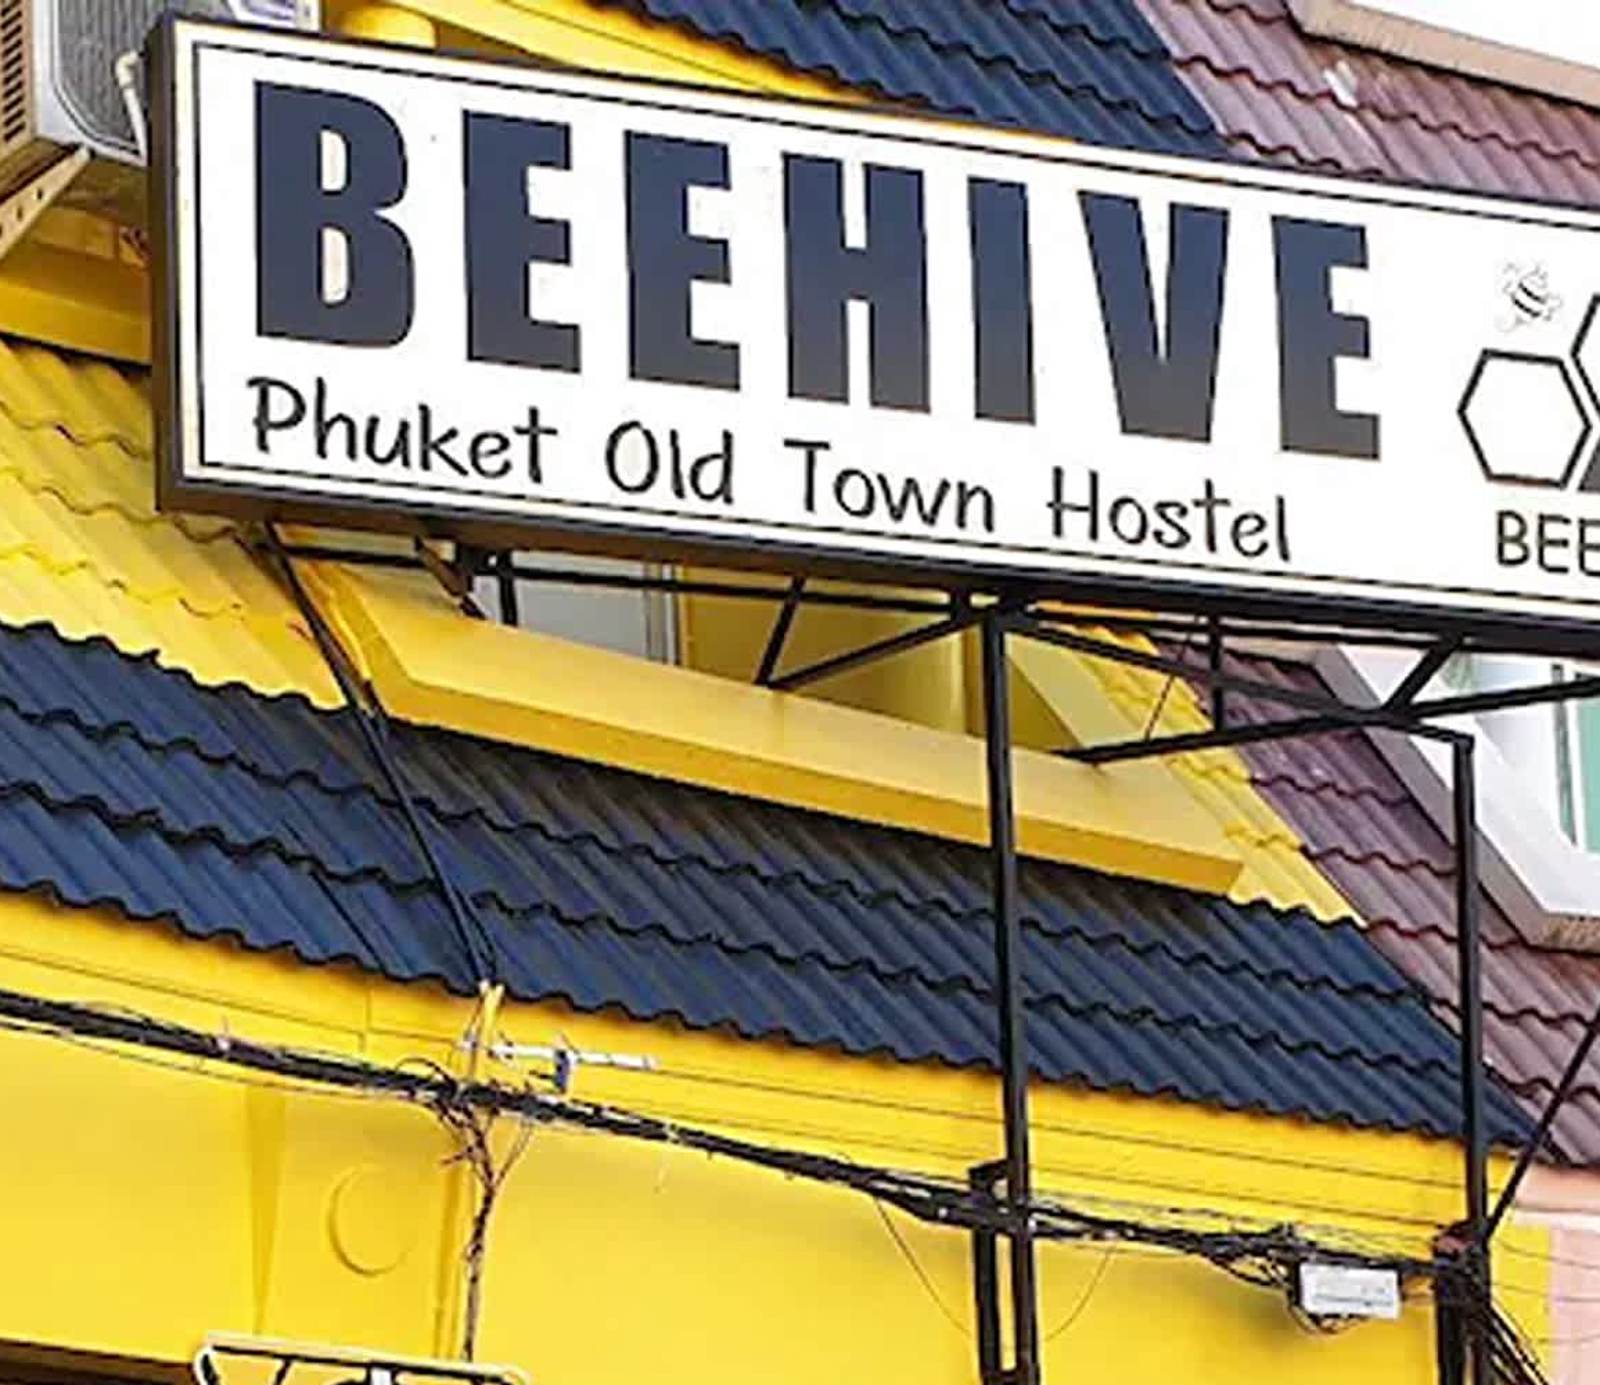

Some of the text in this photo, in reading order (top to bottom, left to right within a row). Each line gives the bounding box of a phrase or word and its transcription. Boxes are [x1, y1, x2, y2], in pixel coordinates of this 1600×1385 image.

[253, 79, 1382, 461] BEEHIVE
[246, 376, 1293, 563] Phuket Old Town Hostel
